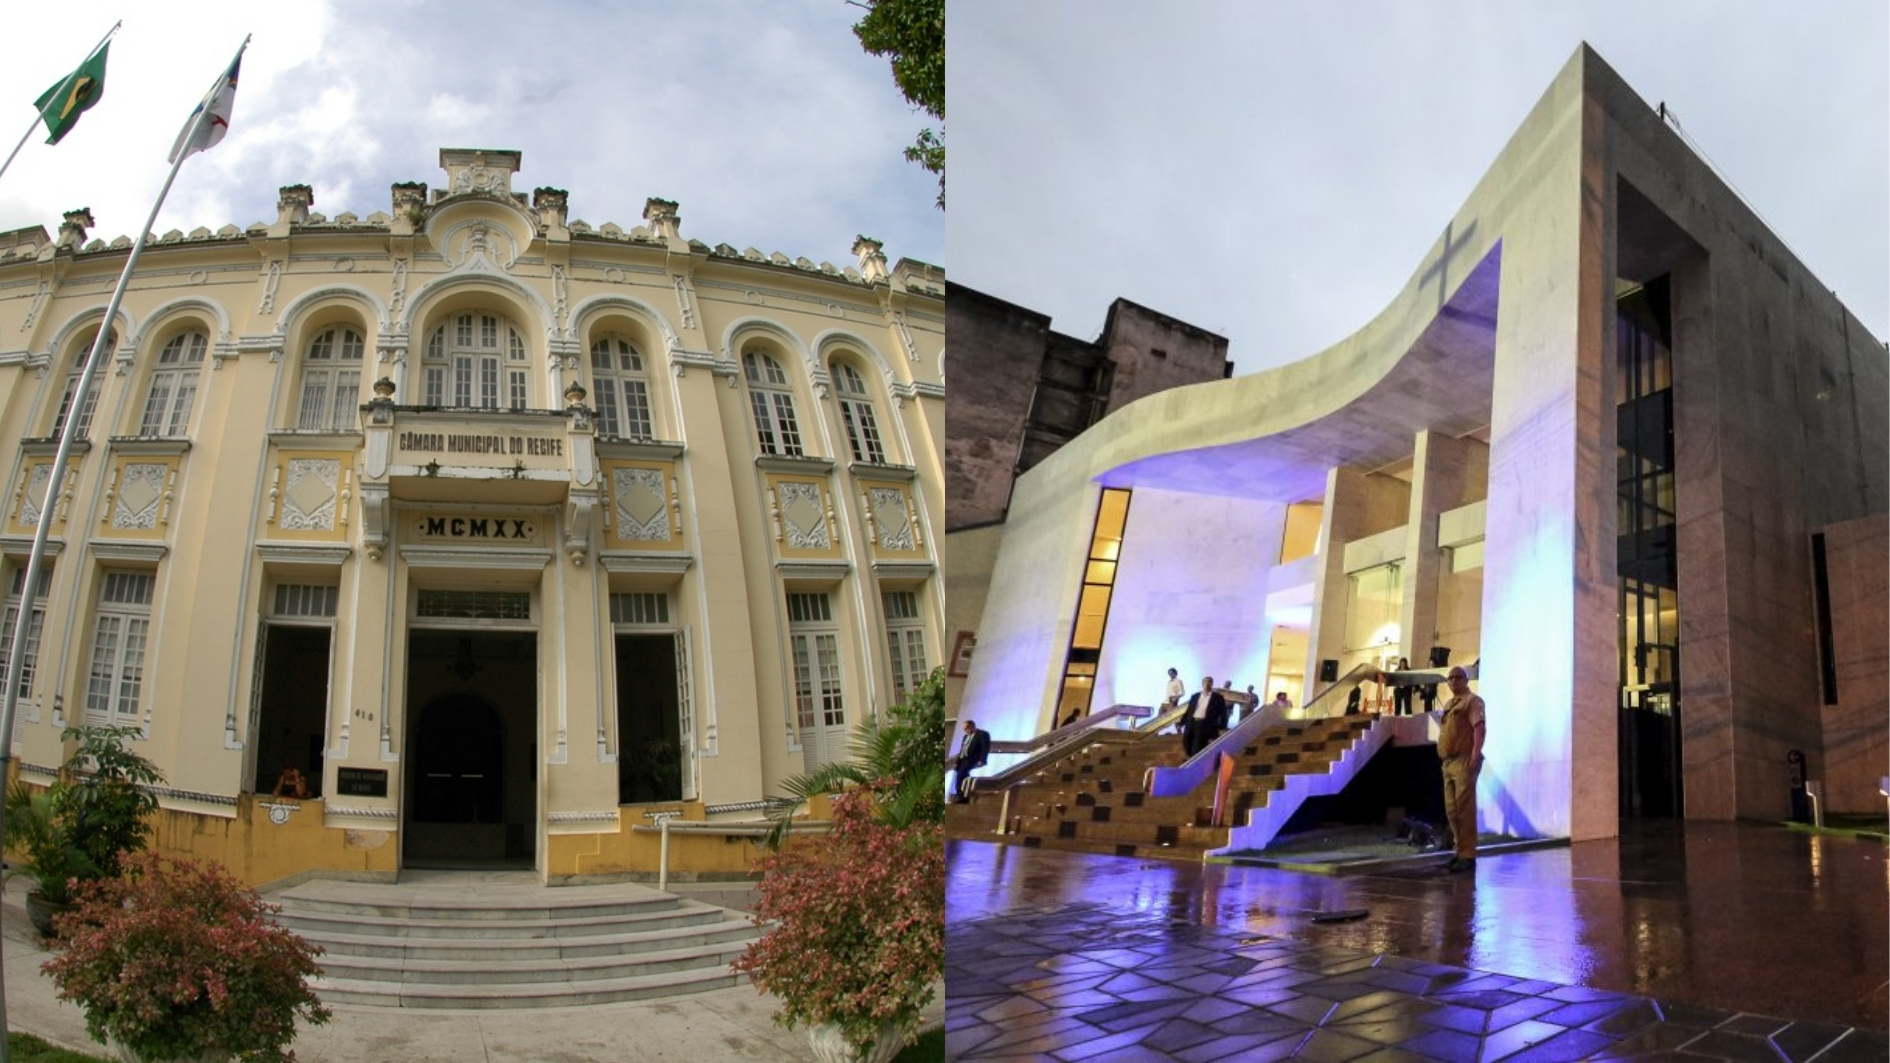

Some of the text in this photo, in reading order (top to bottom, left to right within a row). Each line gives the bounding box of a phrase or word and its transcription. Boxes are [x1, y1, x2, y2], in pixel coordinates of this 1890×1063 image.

[400, 431, 563, 457] CÂMARA MUNICIPAL DO RECIFE
[355, 708, 374, 721] 410
